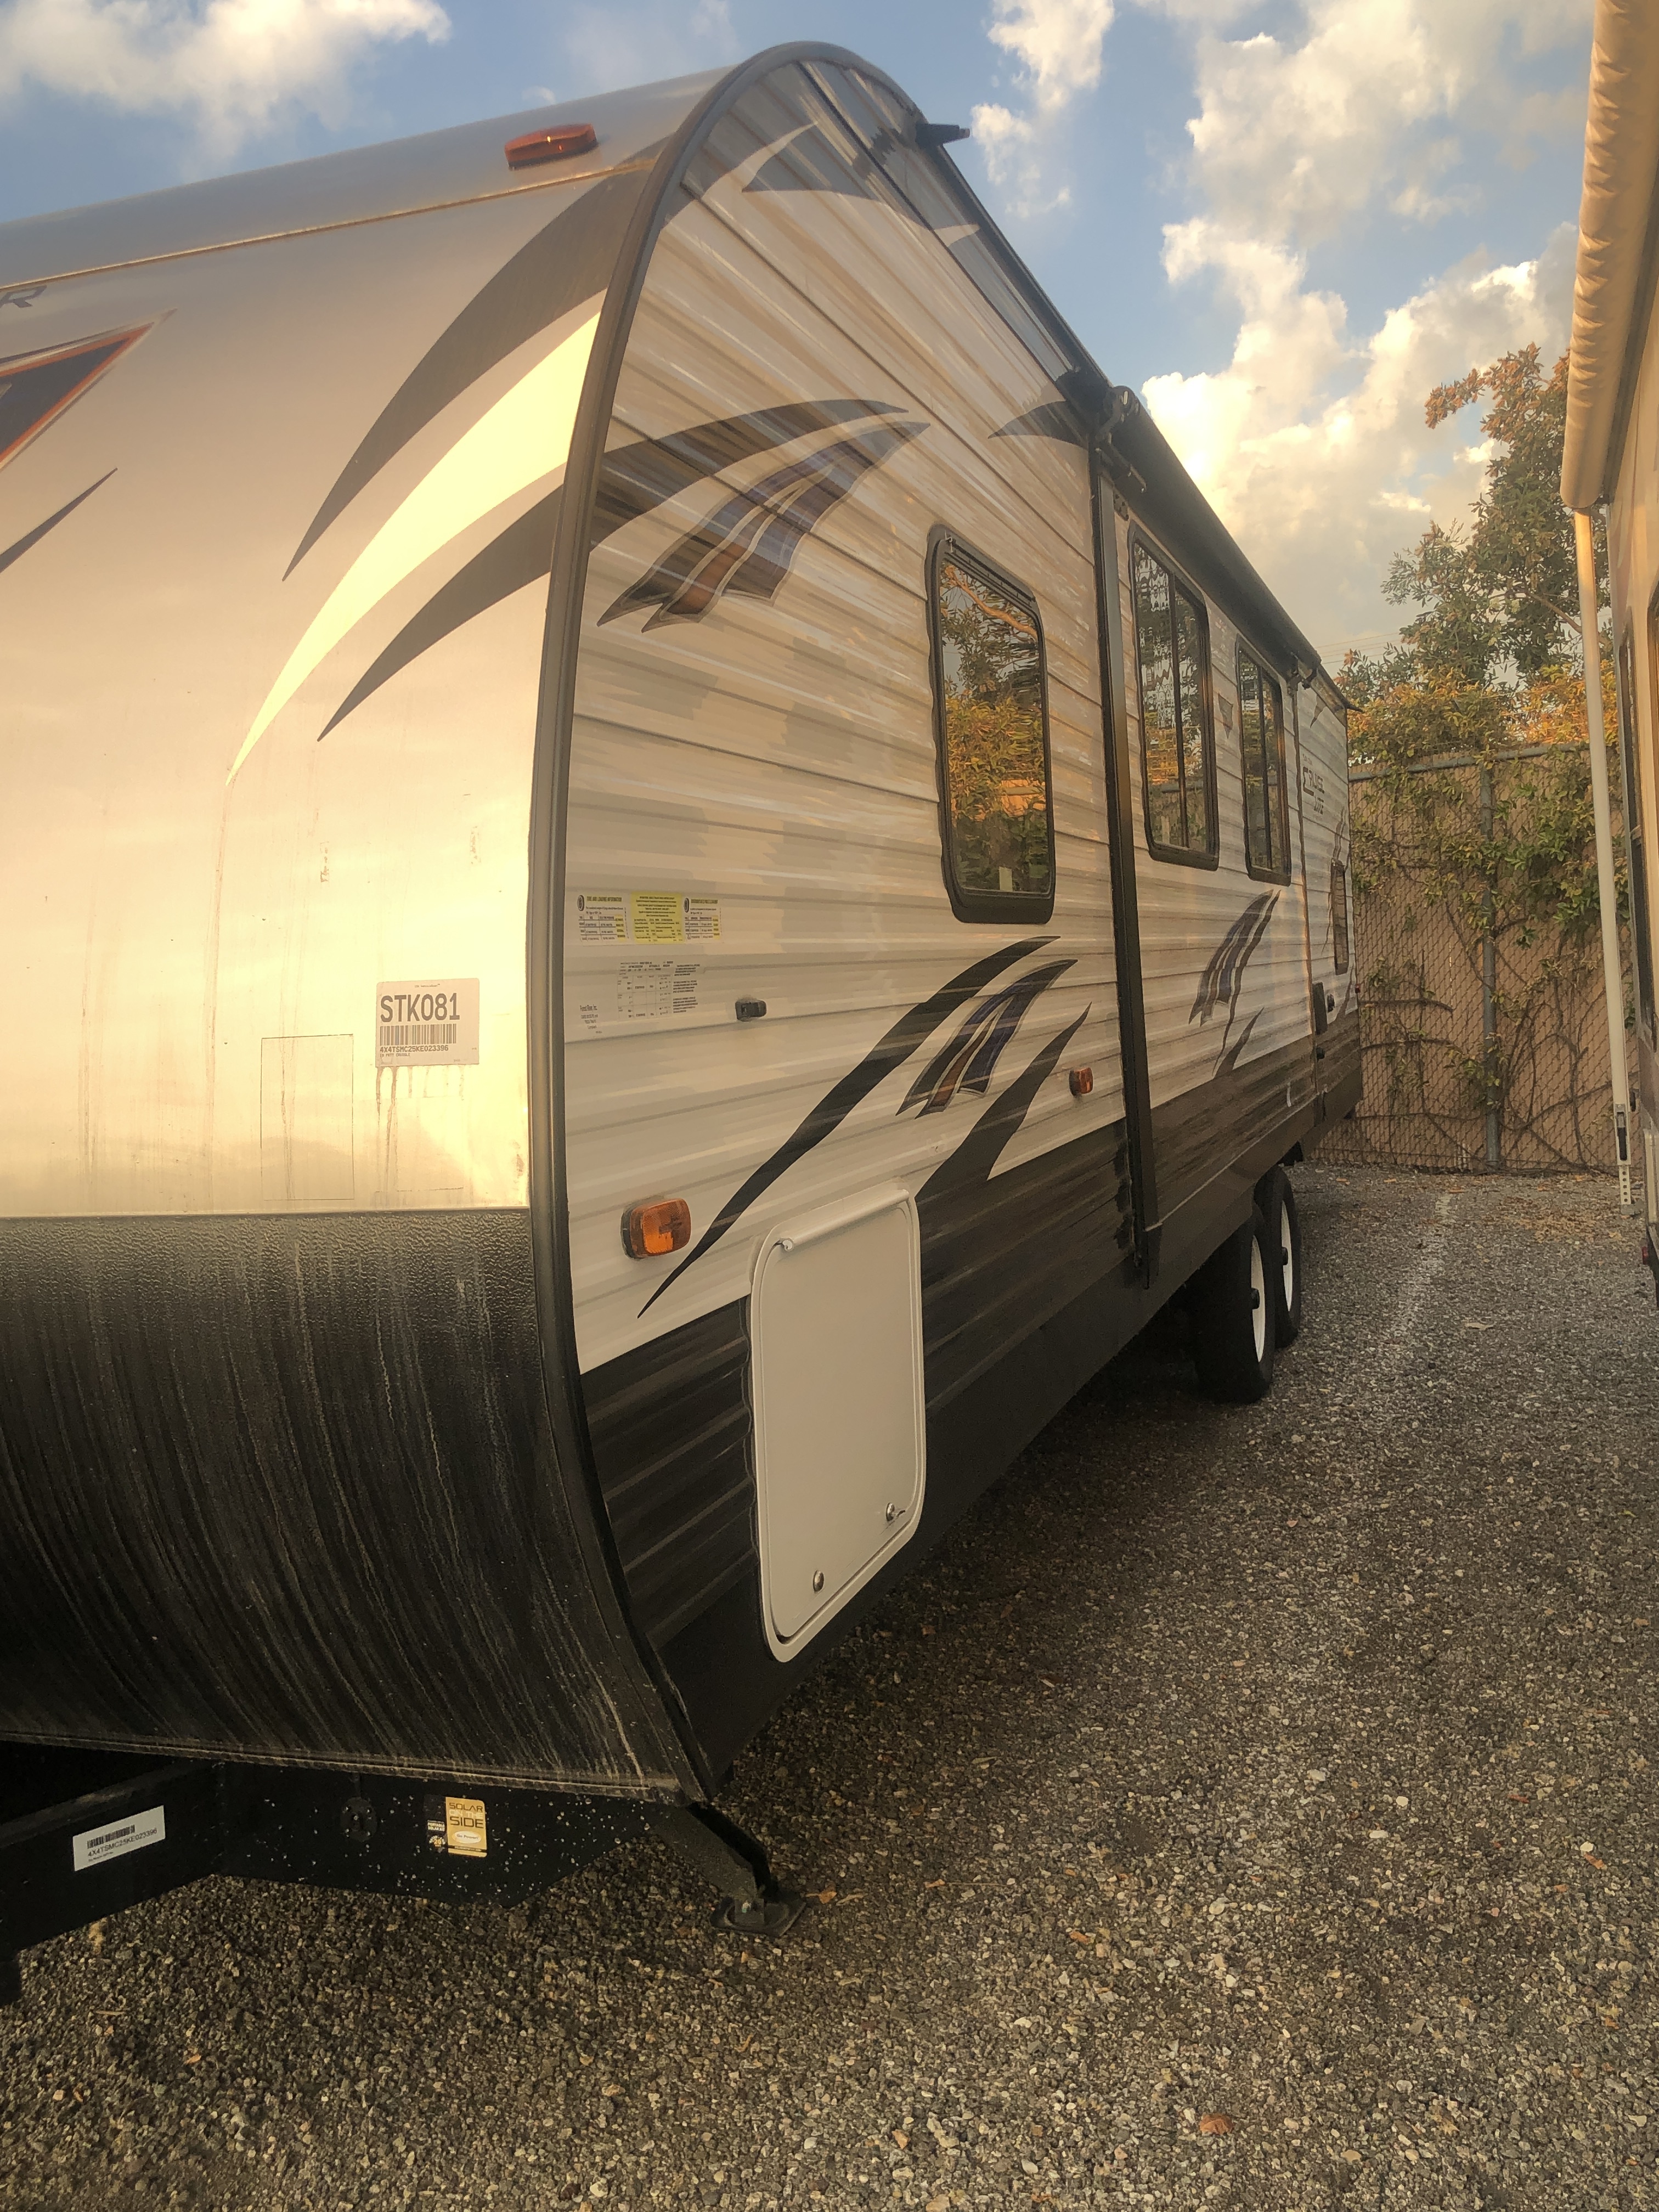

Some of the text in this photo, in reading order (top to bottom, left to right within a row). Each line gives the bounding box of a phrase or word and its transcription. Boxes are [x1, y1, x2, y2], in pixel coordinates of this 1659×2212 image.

[380, 992, 460, 1023] STK081
[449, 1802, 483, 1812] SOLAR
[465, 1811, 483, 1819] THE
[449, 1816, 484, 1829] SIDE
